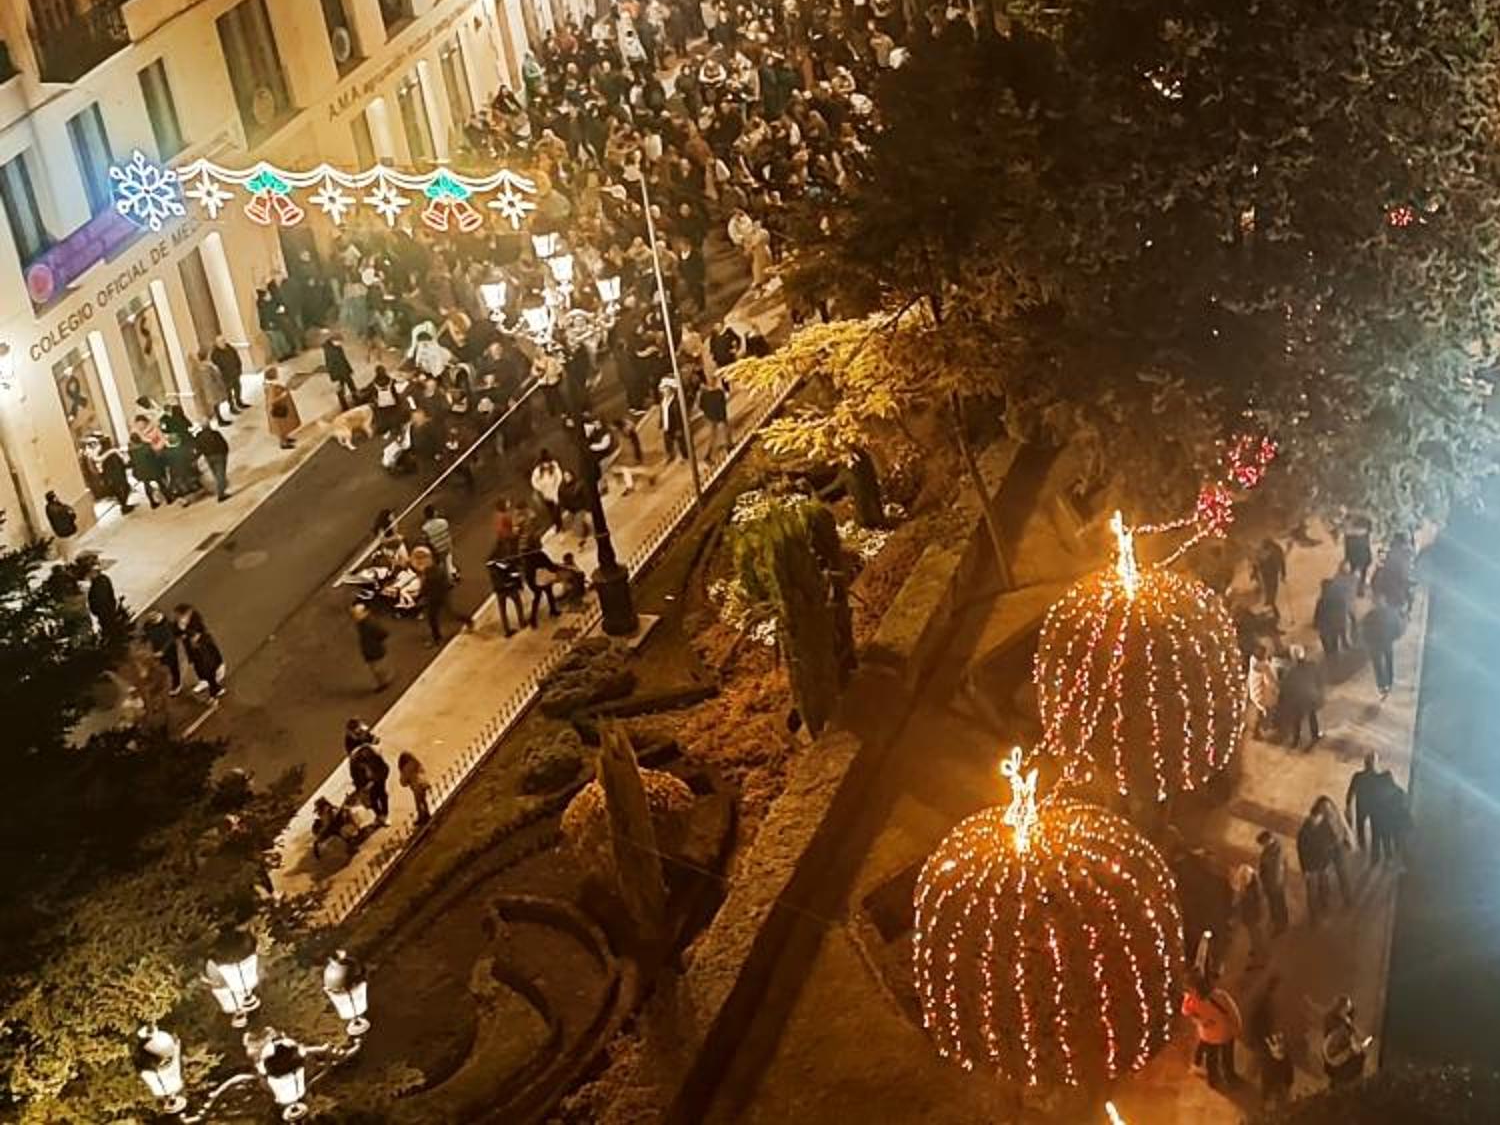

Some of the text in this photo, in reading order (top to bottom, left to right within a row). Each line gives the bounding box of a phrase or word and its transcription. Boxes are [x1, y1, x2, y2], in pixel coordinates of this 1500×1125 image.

[29, 301, 94, 362] COLEGIO
[97, 258, 149, 308] OFICIAL
[150, 238, 169, 265] DE
